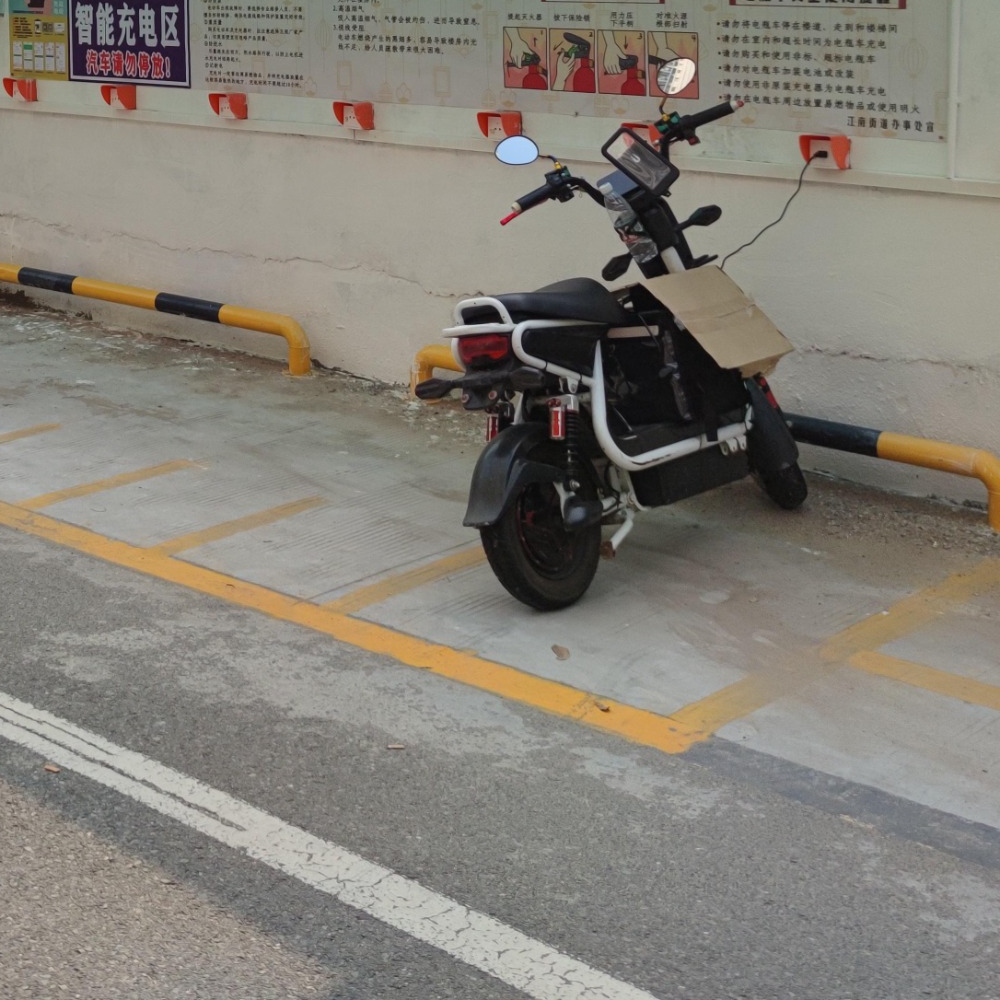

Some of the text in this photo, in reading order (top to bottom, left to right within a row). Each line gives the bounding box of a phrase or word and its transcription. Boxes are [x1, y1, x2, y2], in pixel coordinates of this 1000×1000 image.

[74, 1, 181, 48] 智能充电区
